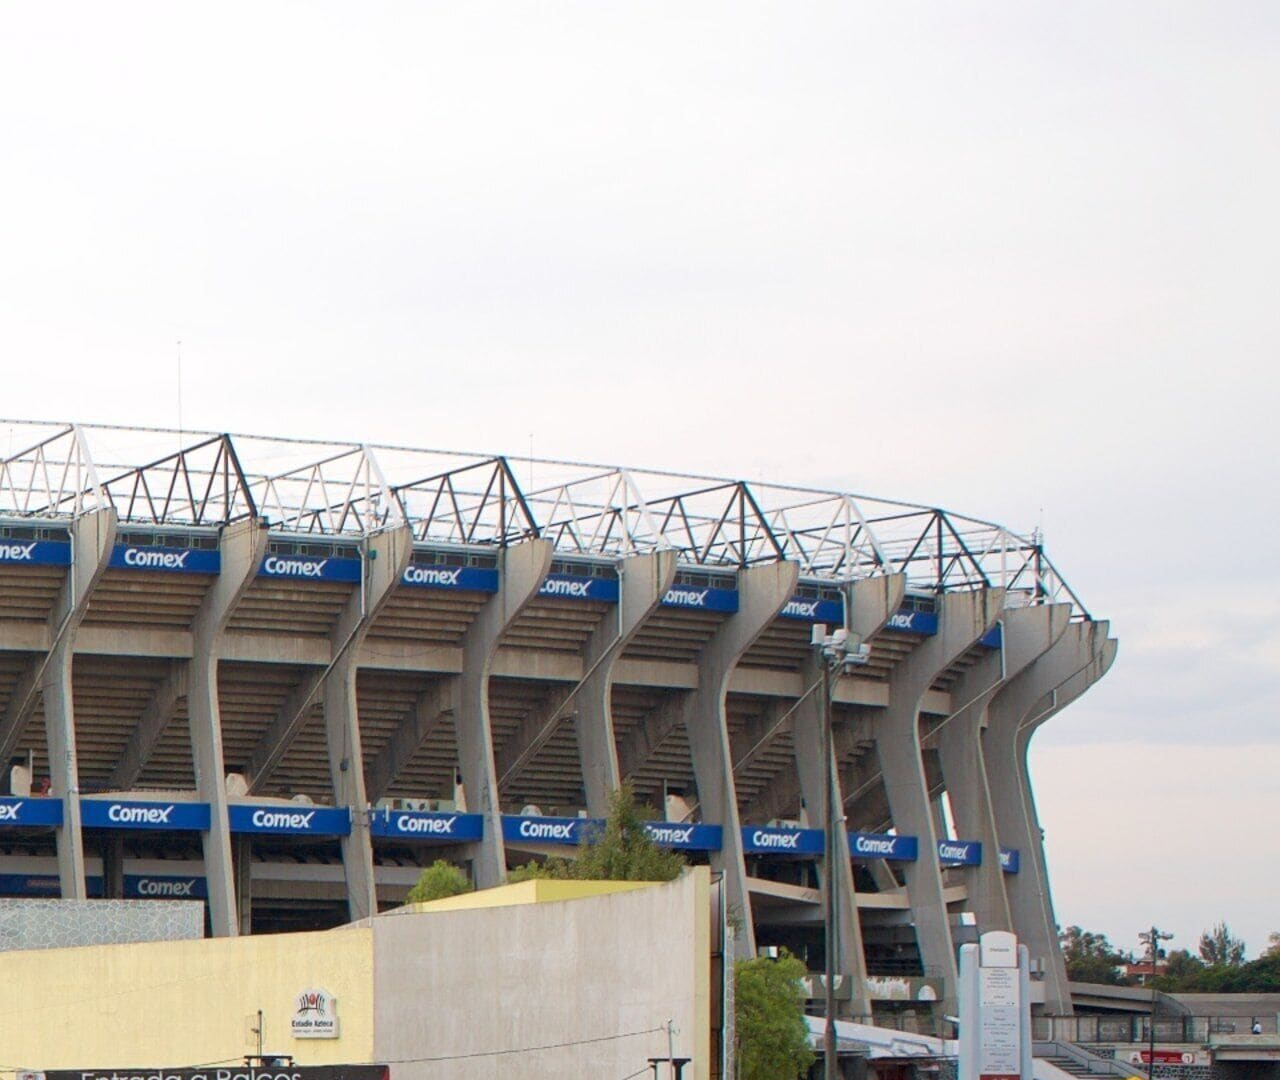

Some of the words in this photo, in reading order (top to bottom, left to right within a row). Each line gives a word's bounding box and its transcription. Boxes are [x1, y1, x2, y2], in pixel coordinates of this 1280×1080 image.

[124, 548, 189, 568] Comex
[264, 557, 328, 576] Comex
[403, 565, 462, 585] Comex
[663, 589, 708, 606] omex
[108, 804, 174, 823] Comex
[252, 809, 315, 828] Comex
[397, 815, 457, 833] Comex
[520, 820, 575, 838] Comex
[753, 830, 801, 848] Comex
[856, 836, 896, 854] Comex
[940, 843, 969, 860] Comex
[137, 879, 196, 896] Comex
